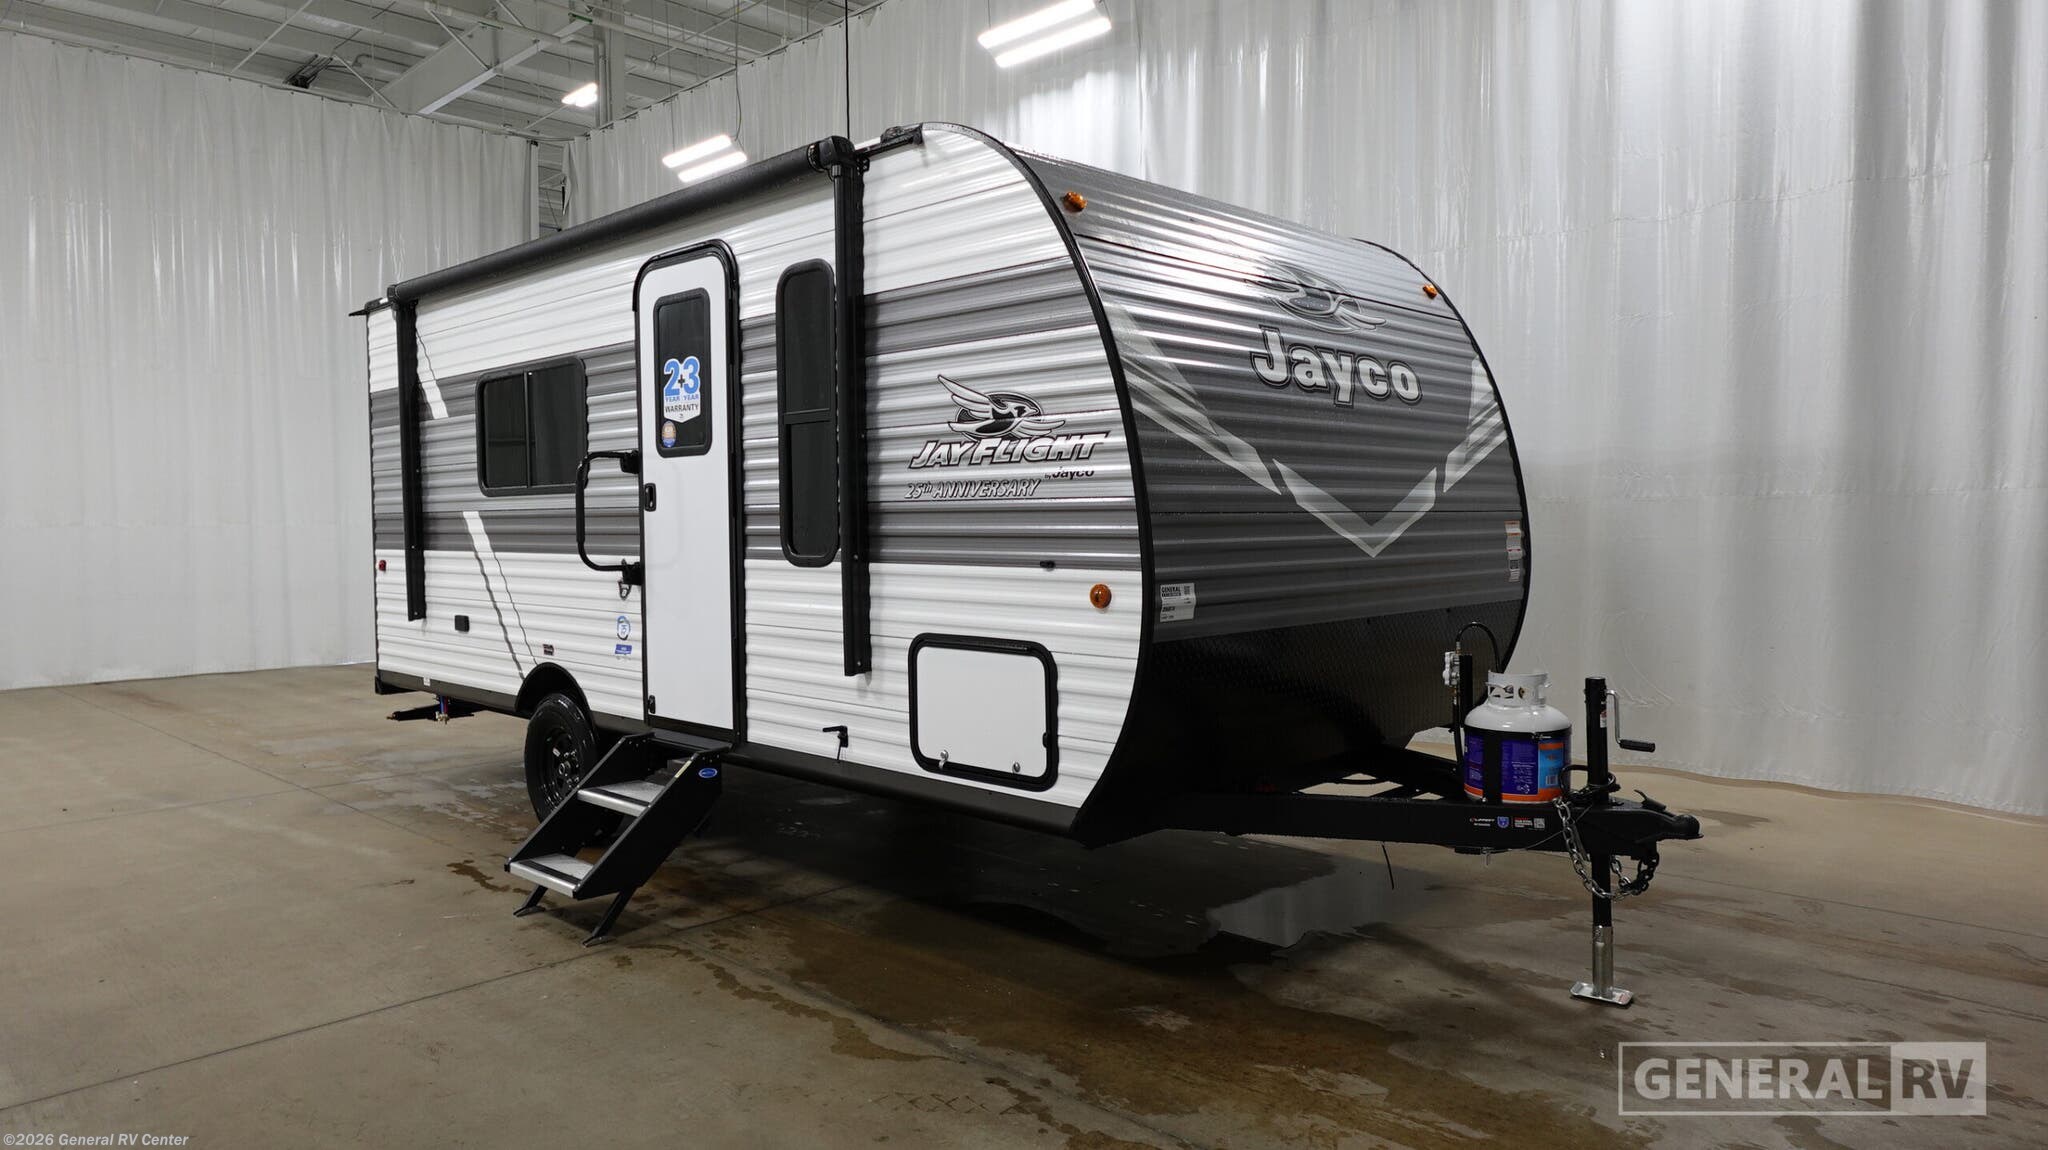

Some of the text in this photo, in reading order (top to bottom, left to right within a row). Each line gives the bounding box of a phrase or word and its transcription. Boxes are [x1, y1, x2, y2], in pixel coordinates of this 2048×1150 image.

[1250, 324, 1423, 409] Jayco
[665, 403, 699, 413] WARRANTY
[908, 431, 1111, 470] JAY FLIGHT
[904, 478, 1041, 499] 25th ANNIVERSARY
